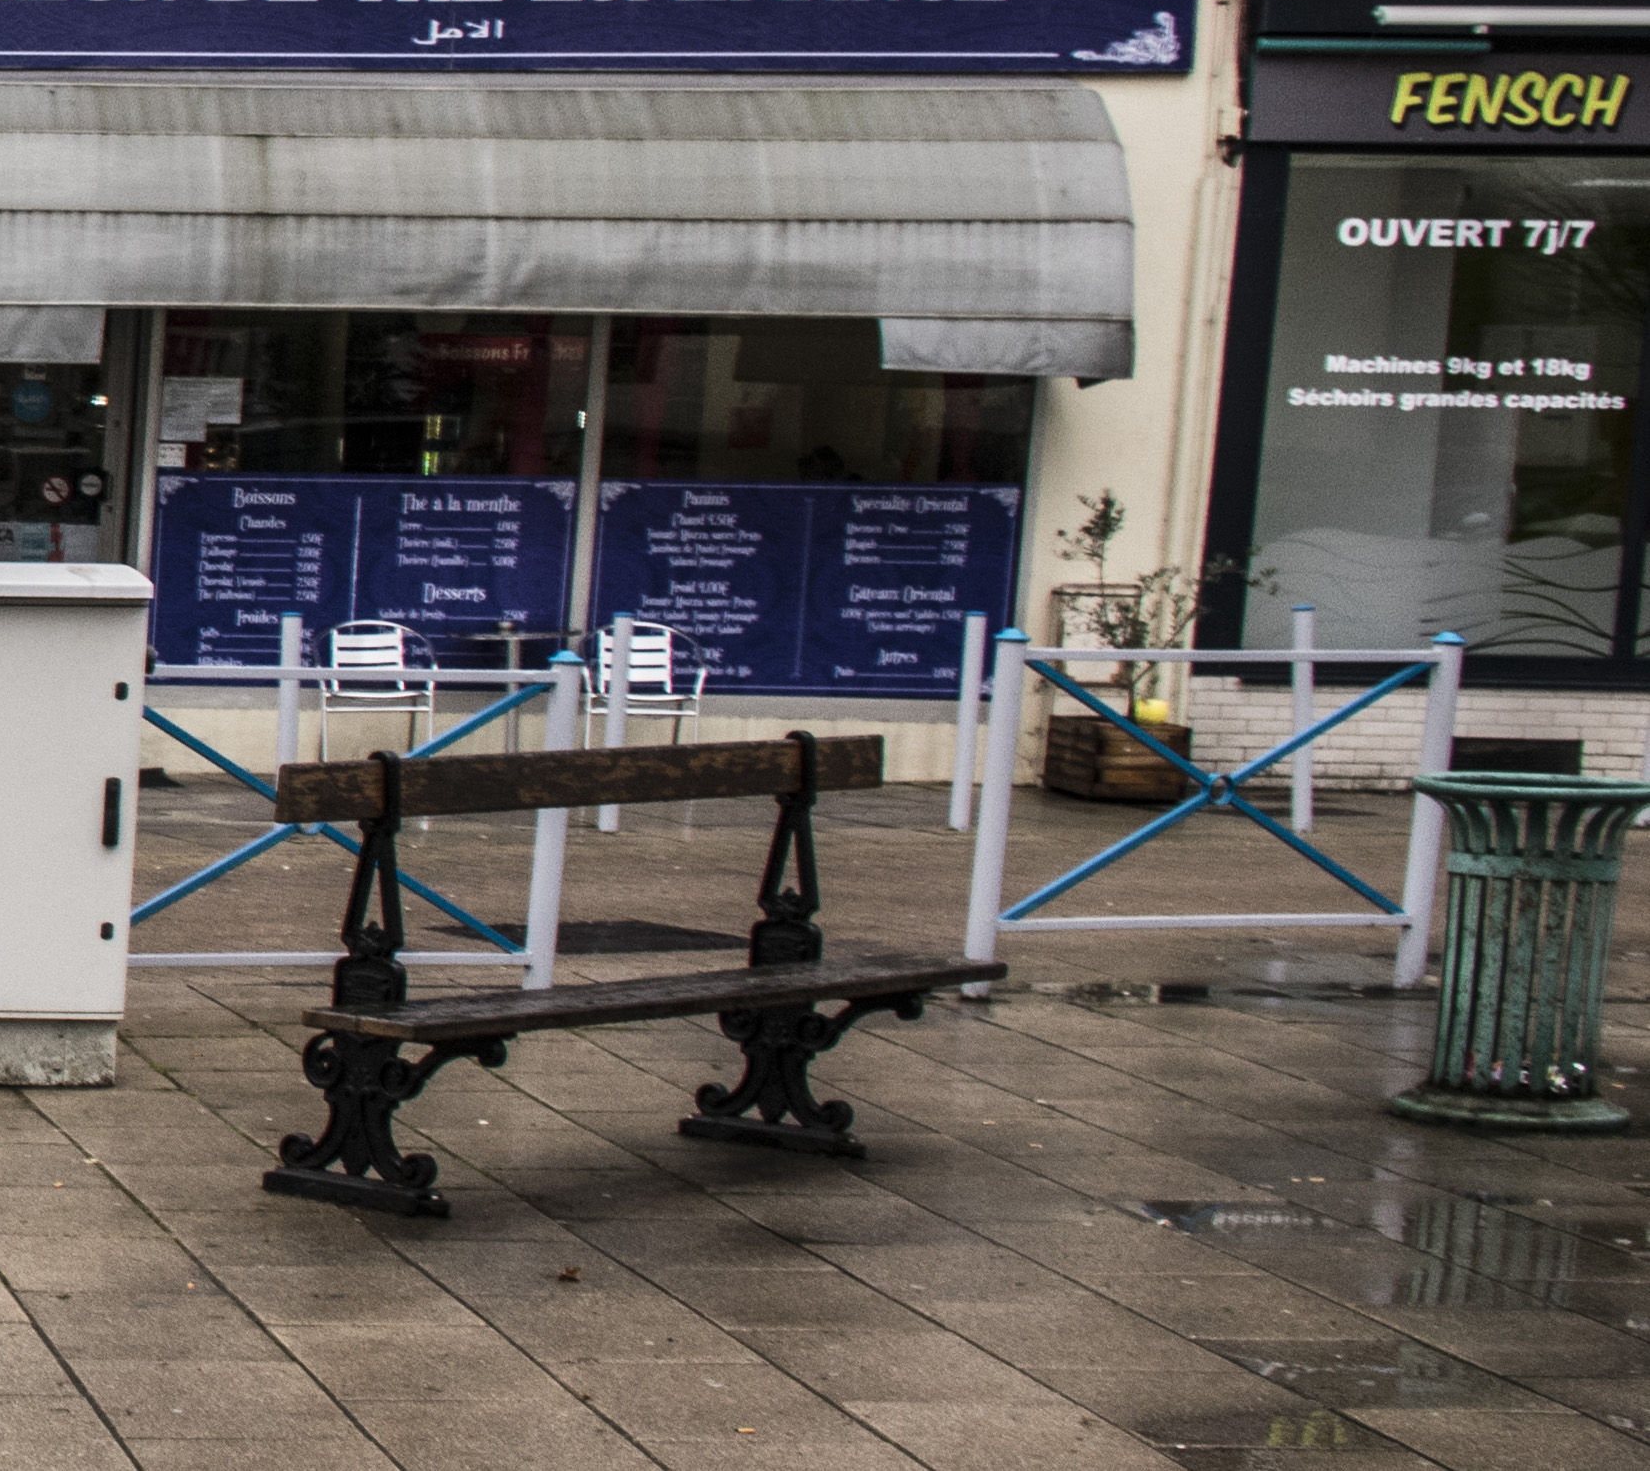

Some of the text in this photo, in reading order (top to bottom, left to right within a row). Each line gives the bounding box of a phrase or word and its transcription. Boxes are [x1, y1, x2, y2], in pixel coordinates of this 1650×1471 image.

[1390, 71, 1631, 127] FENSCH
[1337, 217, 1597, 256] OUVERT 7j/7
[1324, 353, 1592, 381] Machines 9kg et 18kg
[1287, 387, 1628, 412] Séchoirs grandes capacités
[233, 486, 297, 508] Boissons
[447, 493, 463, 512] la
[465, 493, 522, 514] menthe
[423, 582, 487, 604] Desserts
